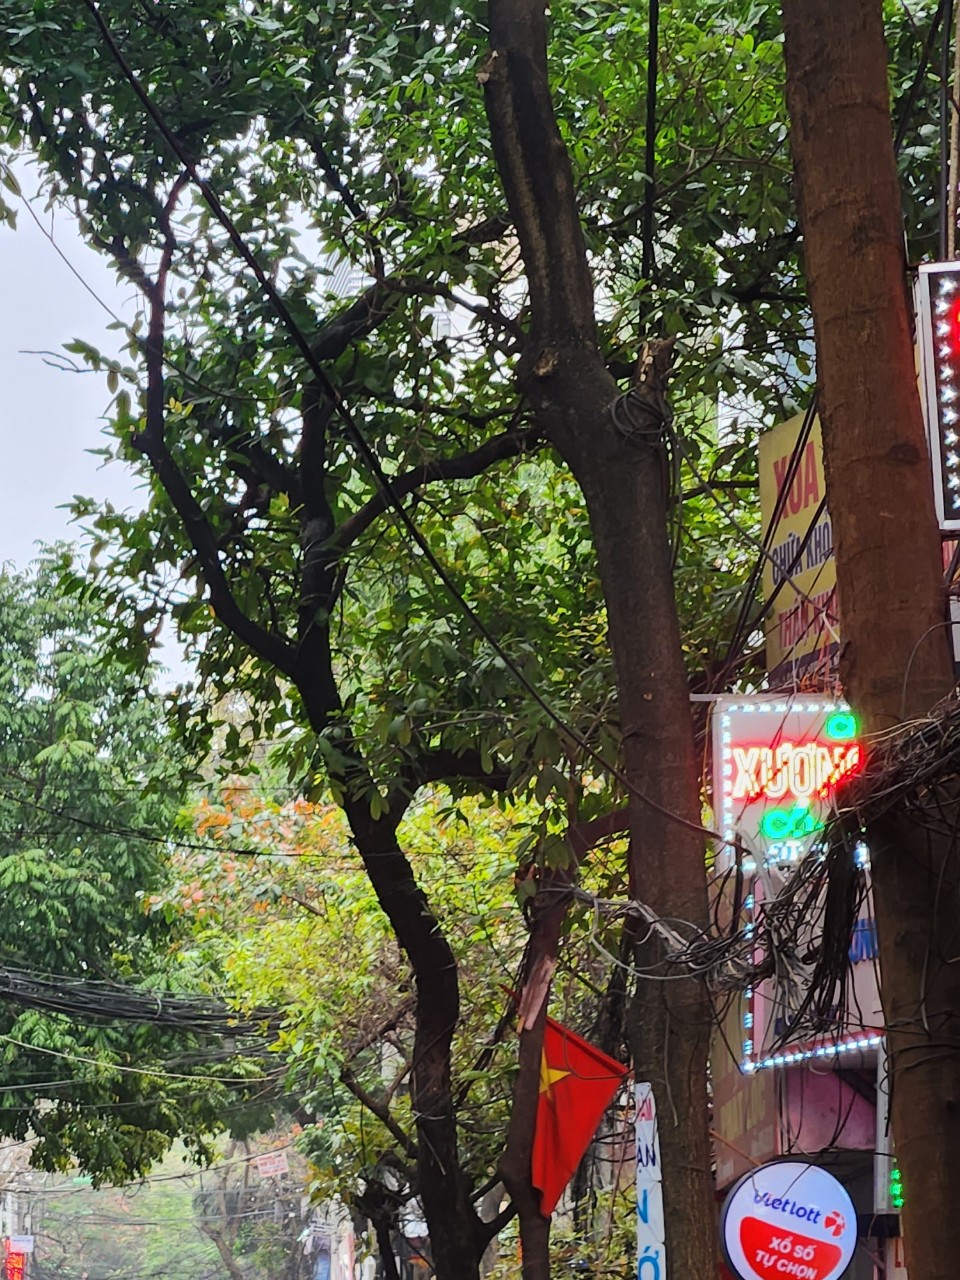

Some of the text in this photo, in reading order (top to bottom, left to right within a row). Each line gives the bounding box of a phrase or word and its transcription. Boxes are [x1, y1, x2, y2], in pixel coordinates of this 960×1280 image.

[755, 1249, 818, 1280] TỰ CHỌN
[793, 1244, 817, 1261] SỐ
